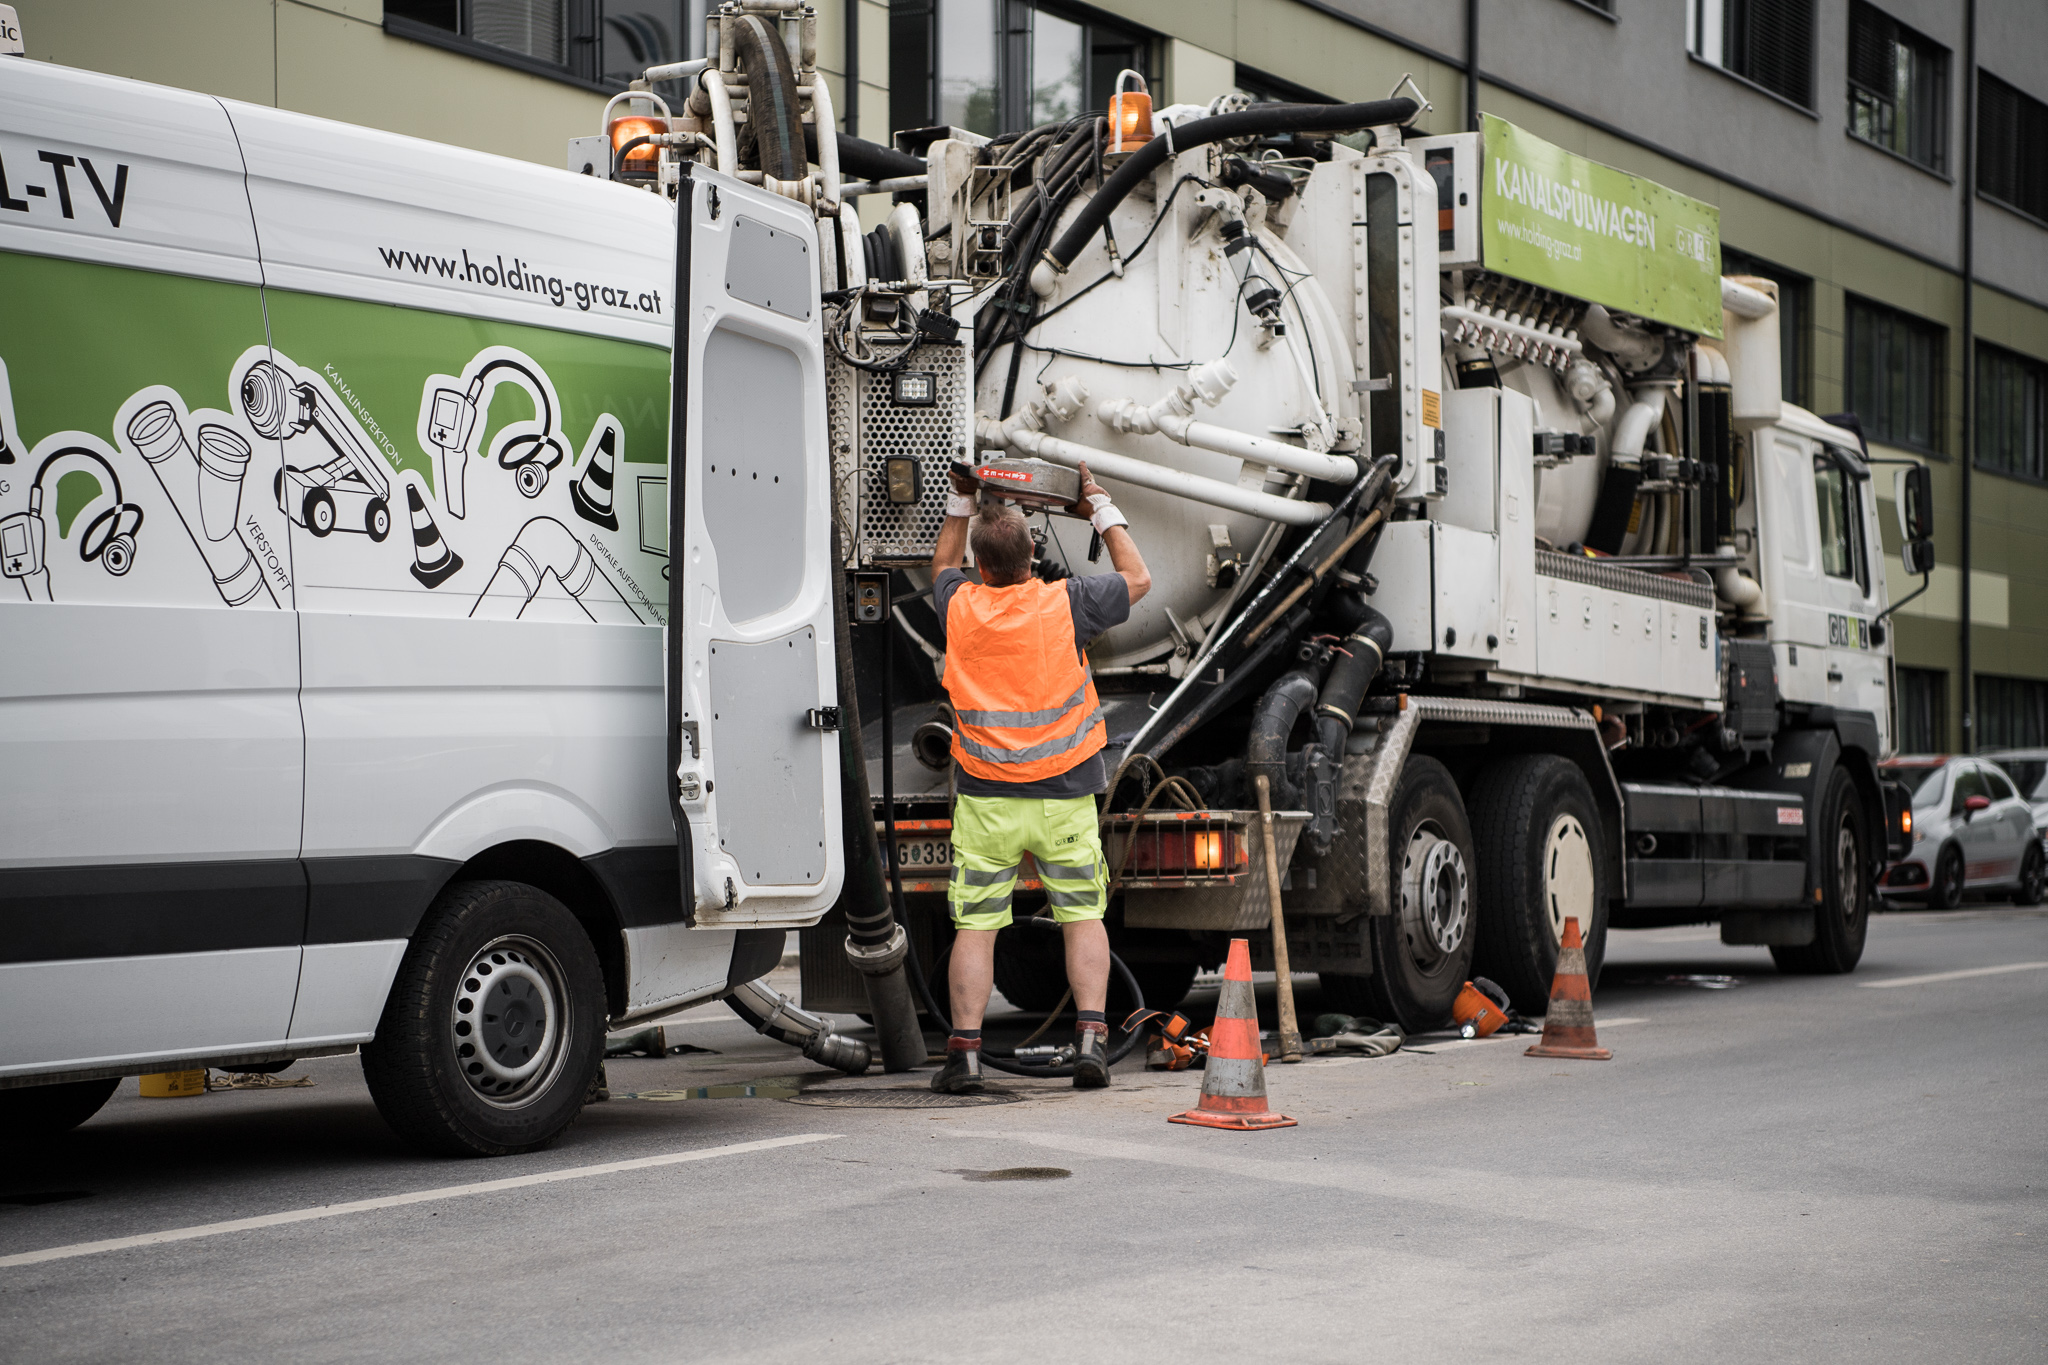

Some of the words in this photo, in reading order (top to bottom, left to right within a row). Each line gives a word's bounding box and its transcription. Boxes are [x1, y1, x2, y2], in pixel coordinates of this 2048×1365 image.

[0, 20, 18, 41] ic
[1496, 157, 1655, 251] KANALSPÜLWAGEN
[1498, 218, 1582, 262] www.holding-graz.at
[378, 247, 662, 314] www.holding-graz.at
[324, 363, 403, 466] KANALINSPEKTION
[246, 514, 292, 591] VERSTOPFT
[589, 533, 619, 569] DIGITALE
[616, 567, 667, 627] AUFZEICHNUNG
[1828, 613, 1869, 650] GRAZ
